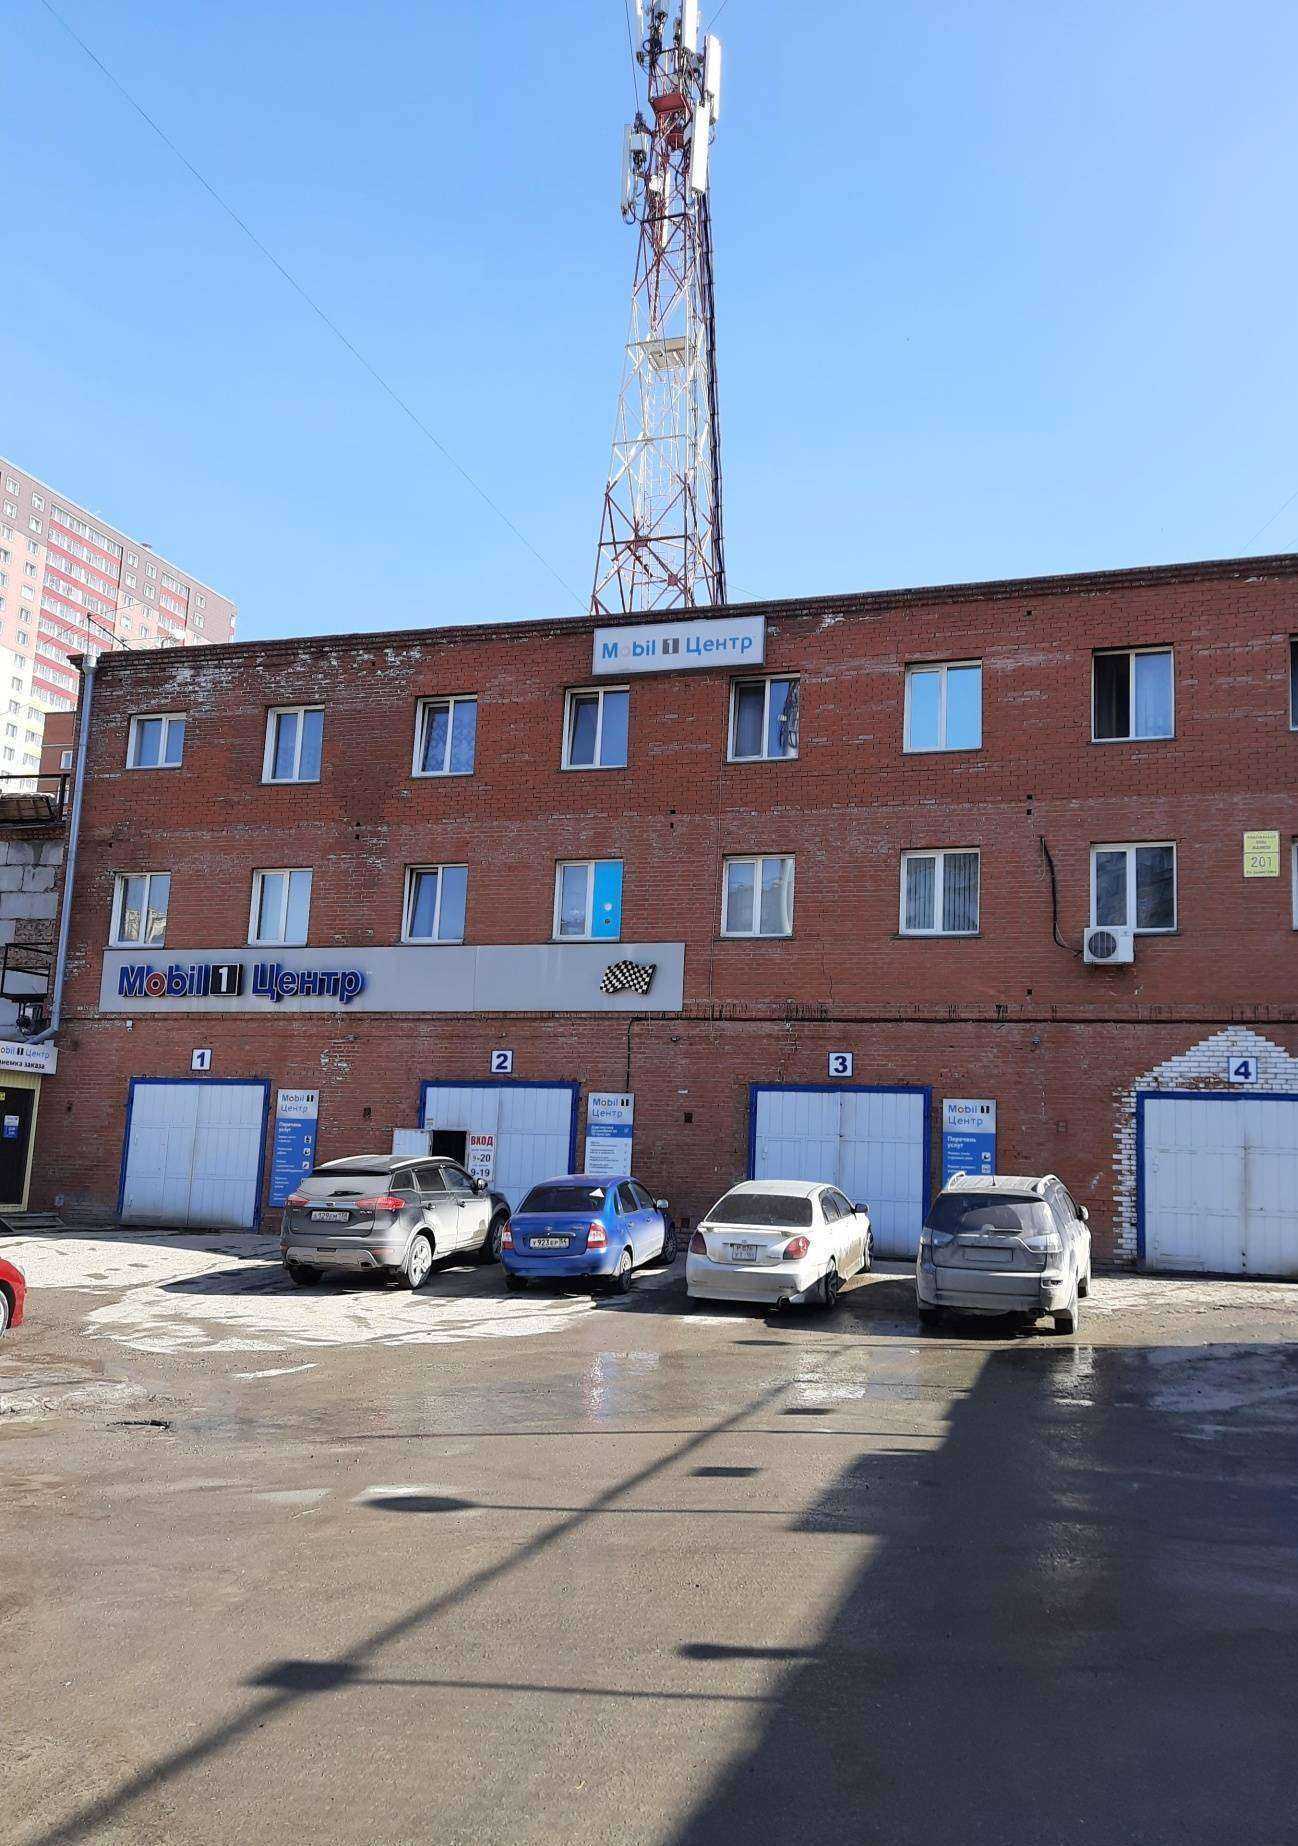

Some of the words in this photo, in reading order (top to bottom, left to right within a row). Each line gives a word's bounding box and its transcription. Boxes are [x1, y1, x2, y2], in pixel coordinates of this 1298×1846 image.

[601, 640, 656, 659] Mobil
[686, 636, 753, 656] Центр
[1250, 856, 1272, 868] 201
[252, 963, 364, 1004] Центр
[0, 1045, 16, 1055] obil
[25, 1049, 50, 1060] Центр
[196, 1051, 206, 1067] 1
[495, 1053, 509, 1070] 2
[833, 1055, 848, 1074] 3
[1234, 1060, 1252, 1080] 4
[281, 1094, 305, 1102] Mobil
[592, 1098, 618, 1107] Mobil
[280, 1104, 308, 1113] Центр
[592, 1108, 623, 1119] Центр
[948, 1104, 977, 1114] Mobil
[948, 1115, 984, 1127] Центр
[470, 1135, 494, 1147] ВХОД
[470, 1168, 490, 1177] 9-19
